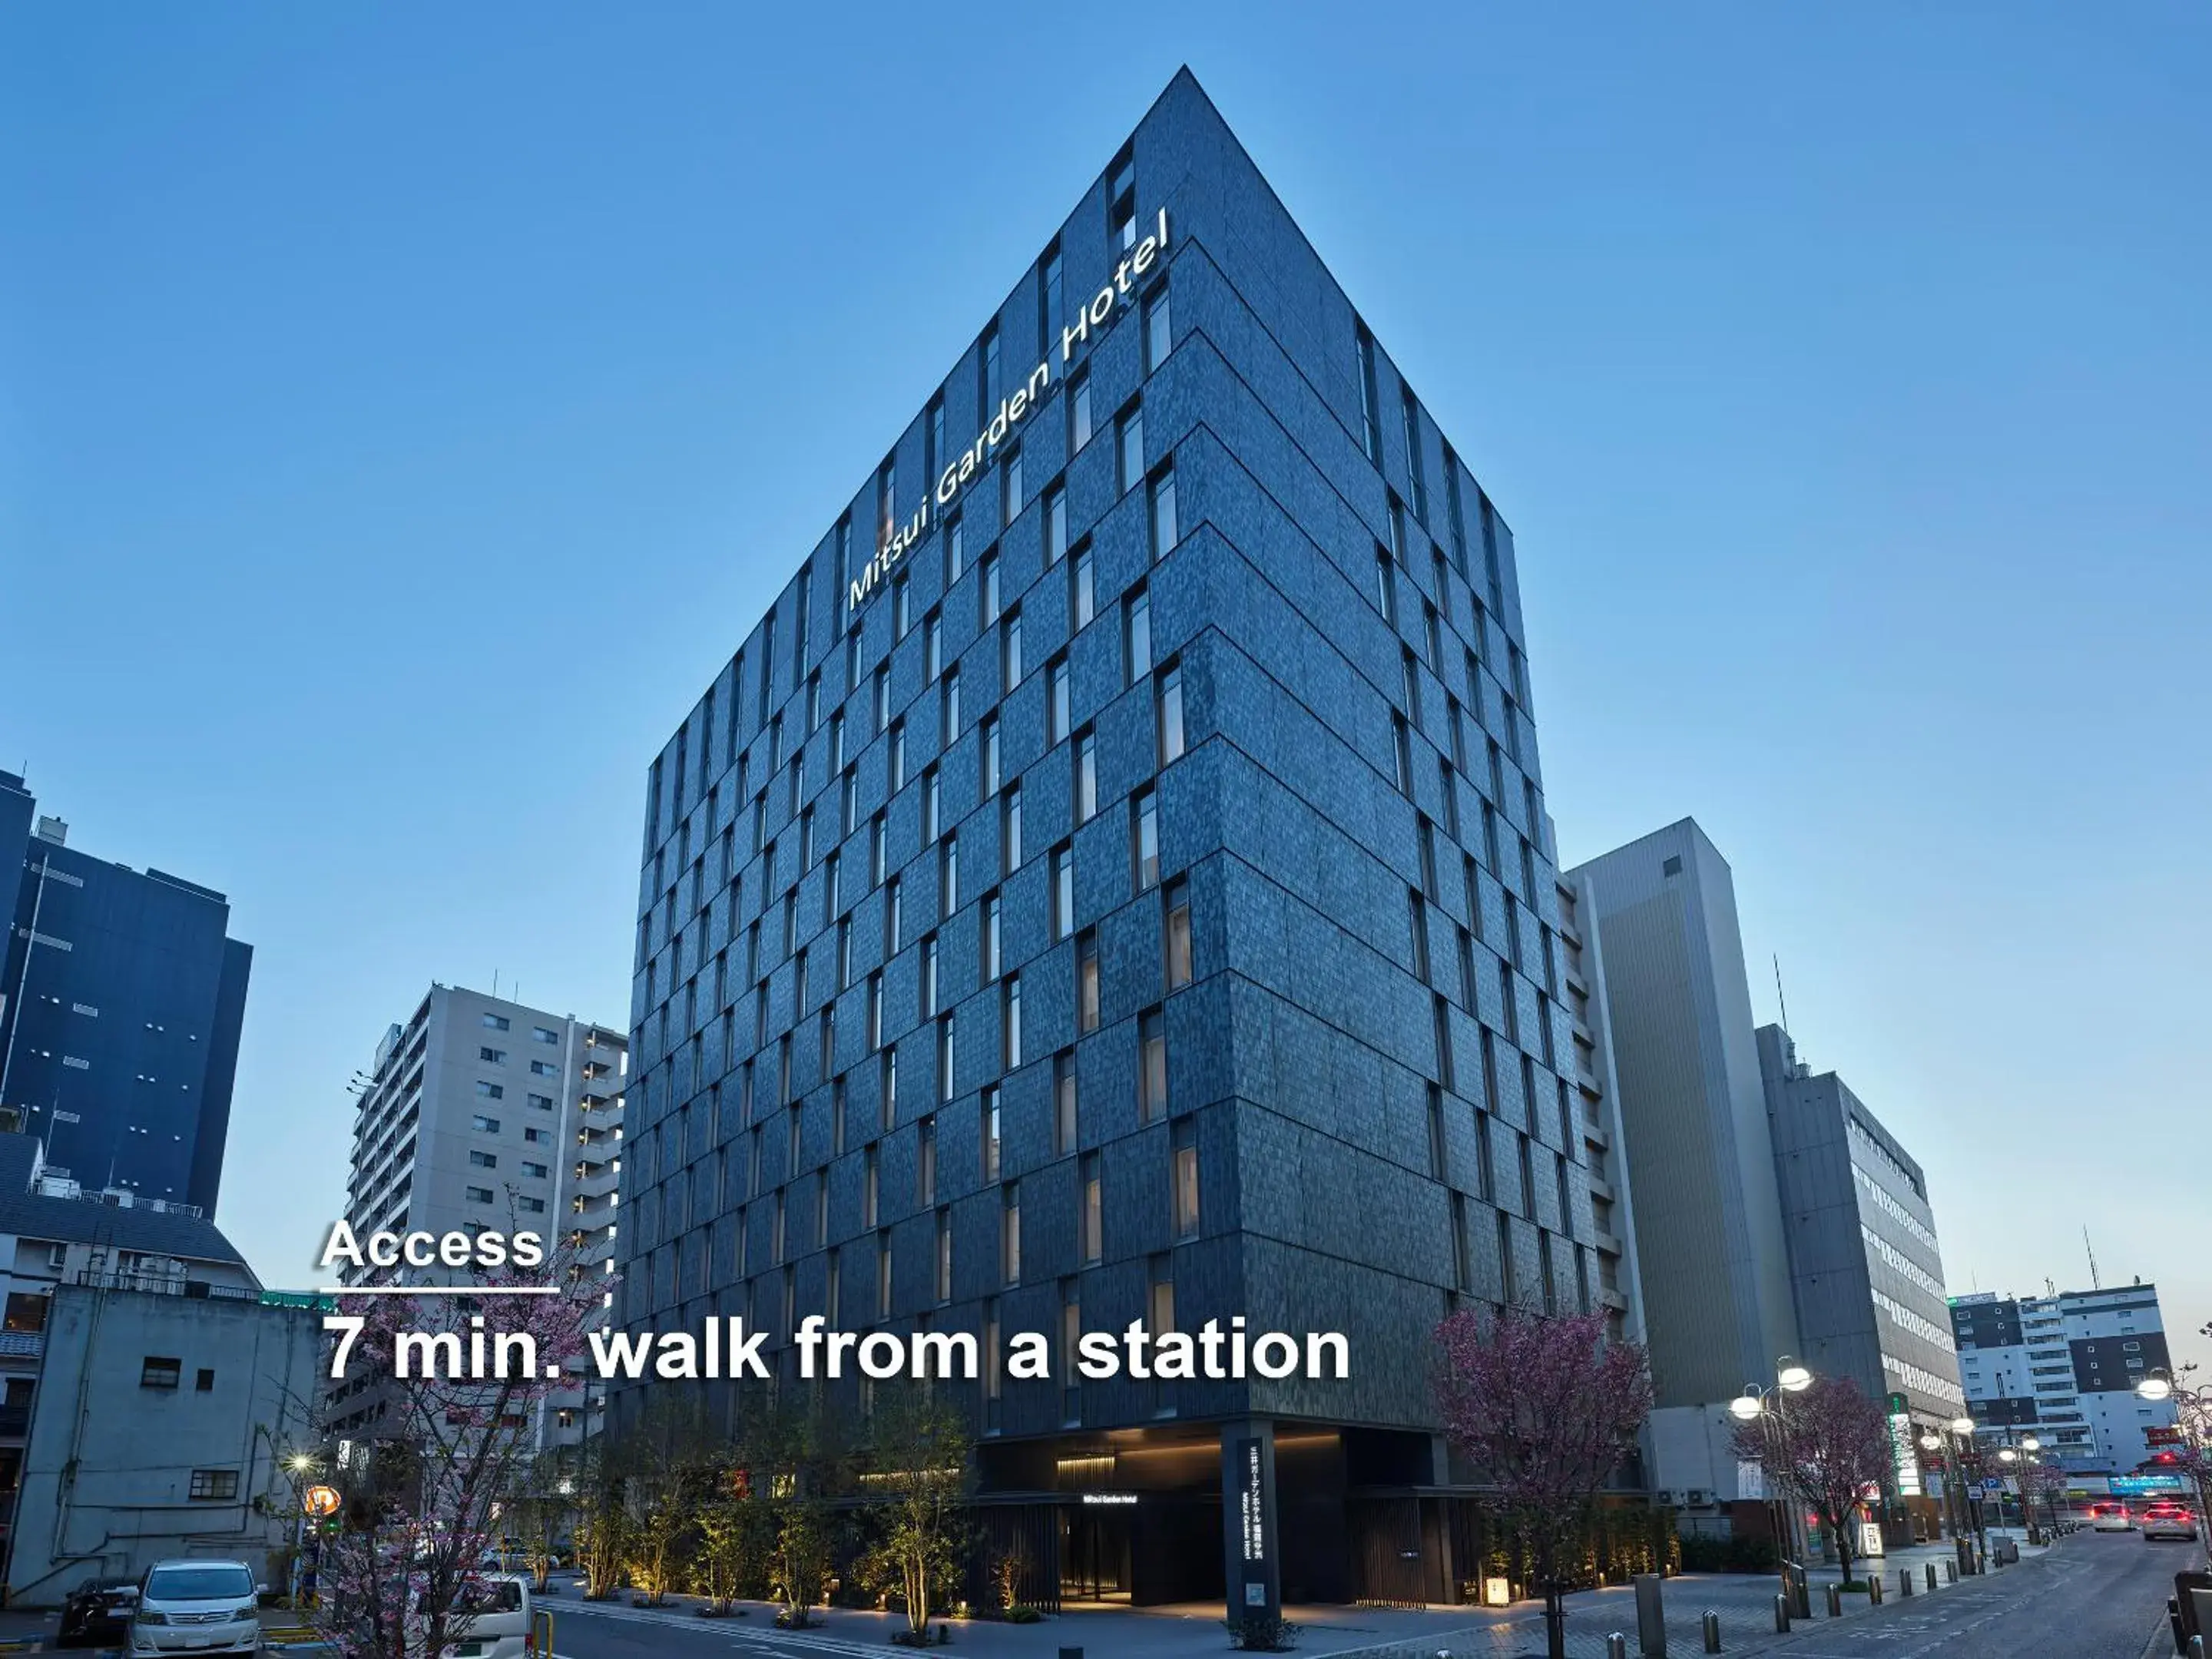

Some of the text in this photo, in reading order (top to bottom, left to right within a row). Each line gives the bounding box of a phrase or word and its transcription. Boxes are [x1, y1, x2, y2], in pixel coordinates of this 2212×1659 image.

[849, 206, 1167, 611] Mitsui Garden Hotel
